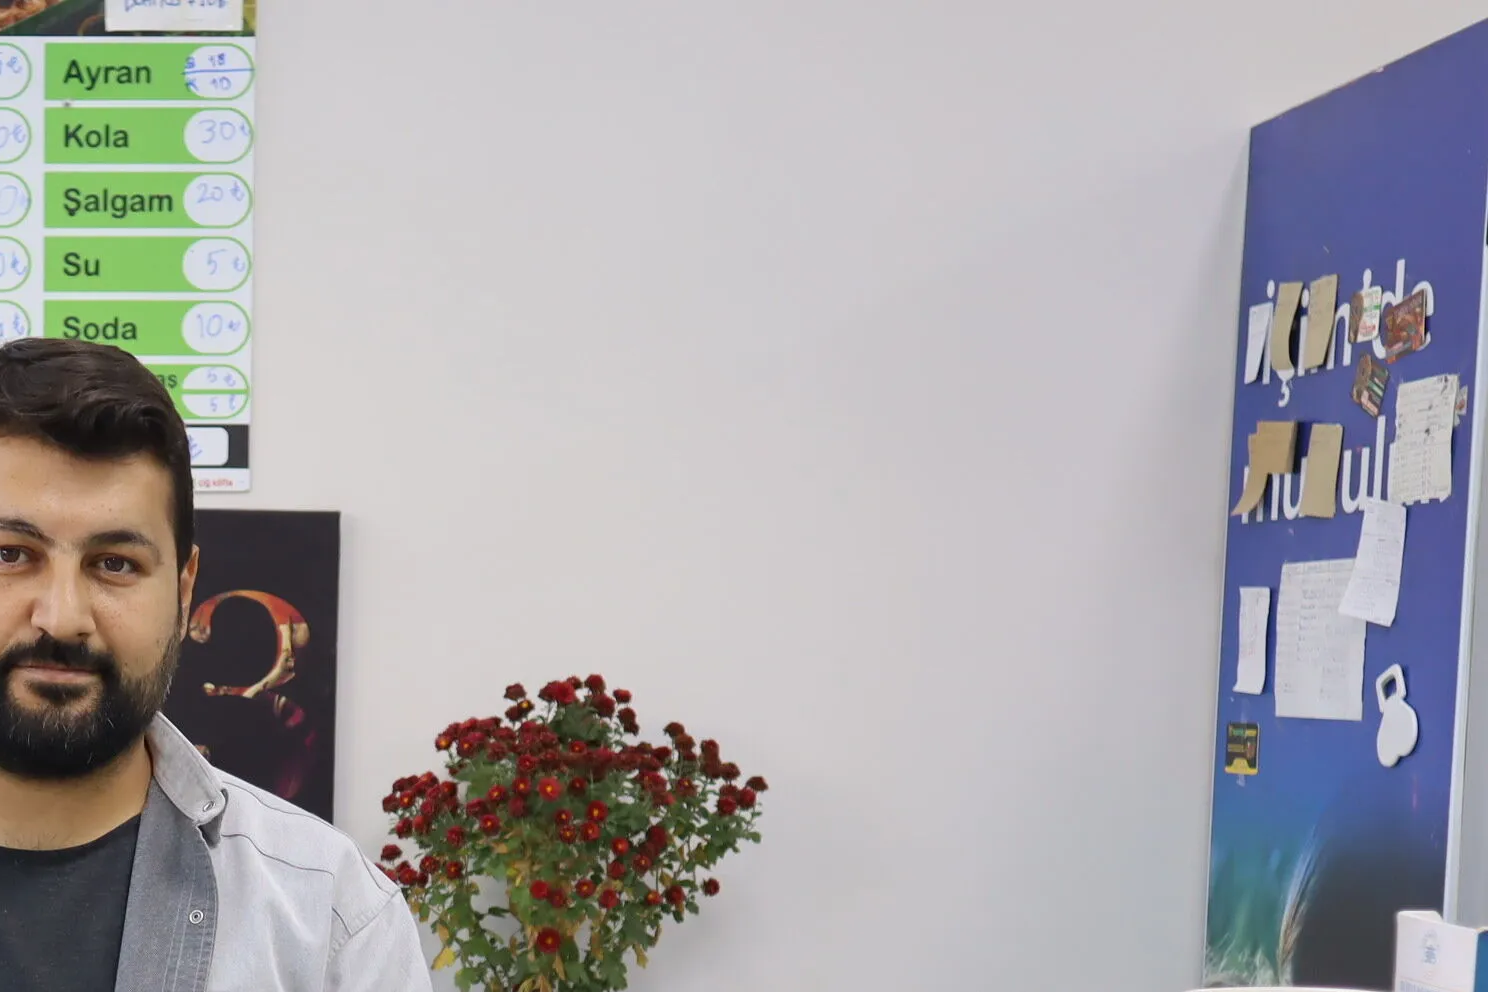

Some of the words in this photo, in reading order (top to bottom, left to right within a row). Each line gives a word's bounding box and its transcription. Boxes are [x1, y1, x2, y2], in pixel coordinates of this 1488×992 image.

[63, 60, 152, 91] Ayran
[63, 123, 129, 148] Kola
[63, 187, 173, 219] Şalgam
[63, 251, 100, 277] Su
[63, 315, 137, 340] Soda
